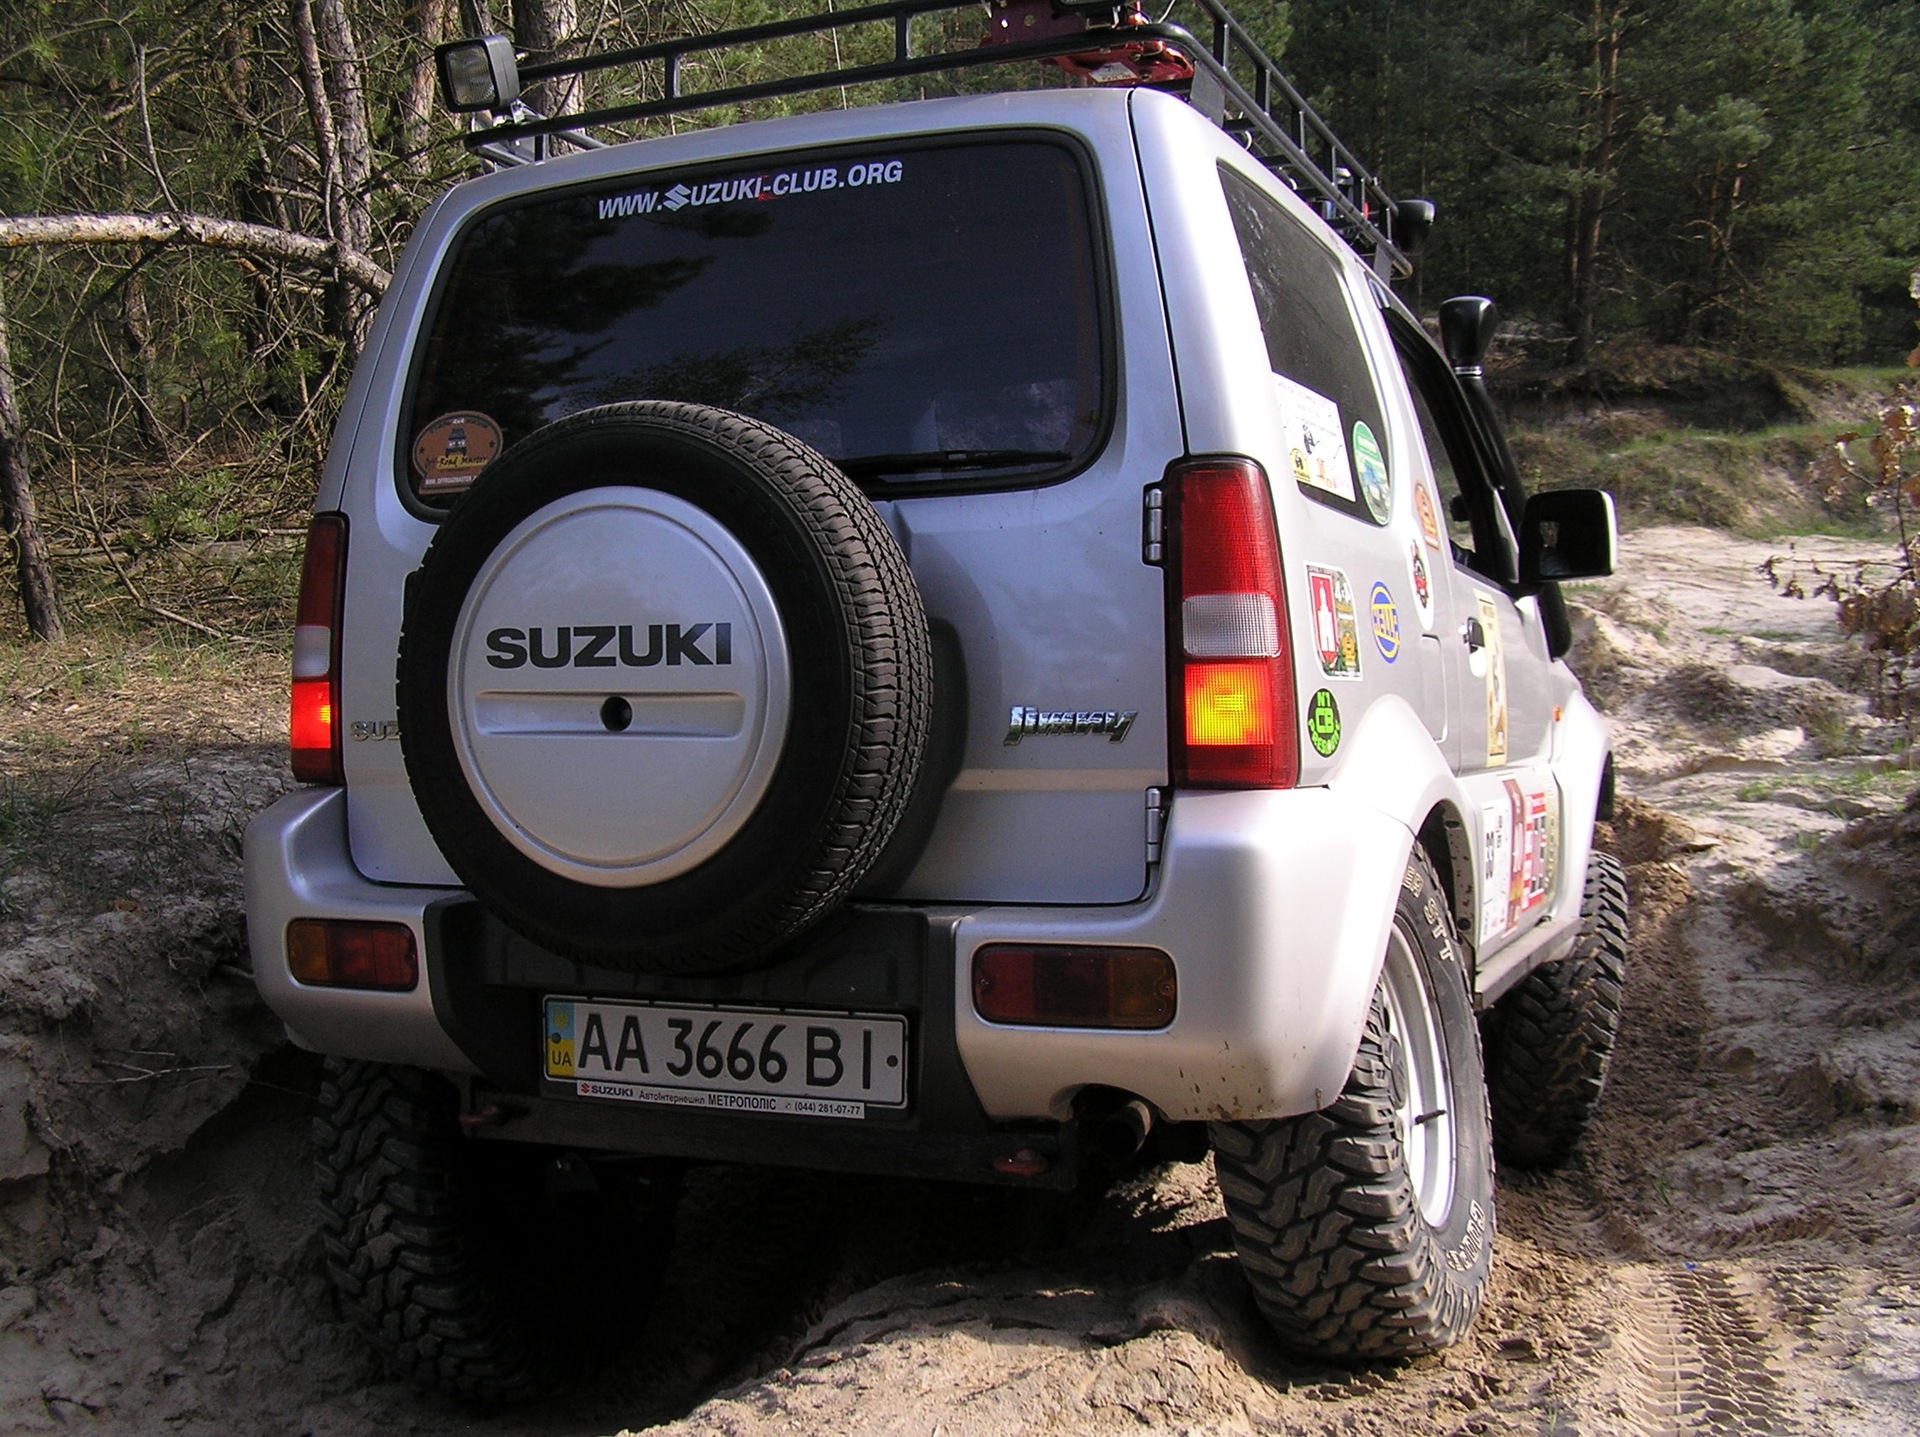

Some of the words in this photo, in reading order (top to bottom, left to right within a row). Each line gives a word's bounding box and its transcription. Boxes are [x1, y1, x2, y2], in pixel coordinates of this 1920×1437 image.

[486, 622, 732, 669] SUZUKI
[350, 720, 401, 741] SUZ
[551, 1050, 572, 1067] UA
[578, 1012, 650, 1074] AA
[665, 1018, 788, 1084] 3666
[805, 1026, 872, 1090] BI
[591, 1085, 634, 1097] SUZUKI
[794, 1101, 817, 1114] (044)
[818, 1102, 861, 1115] 281-07-77
